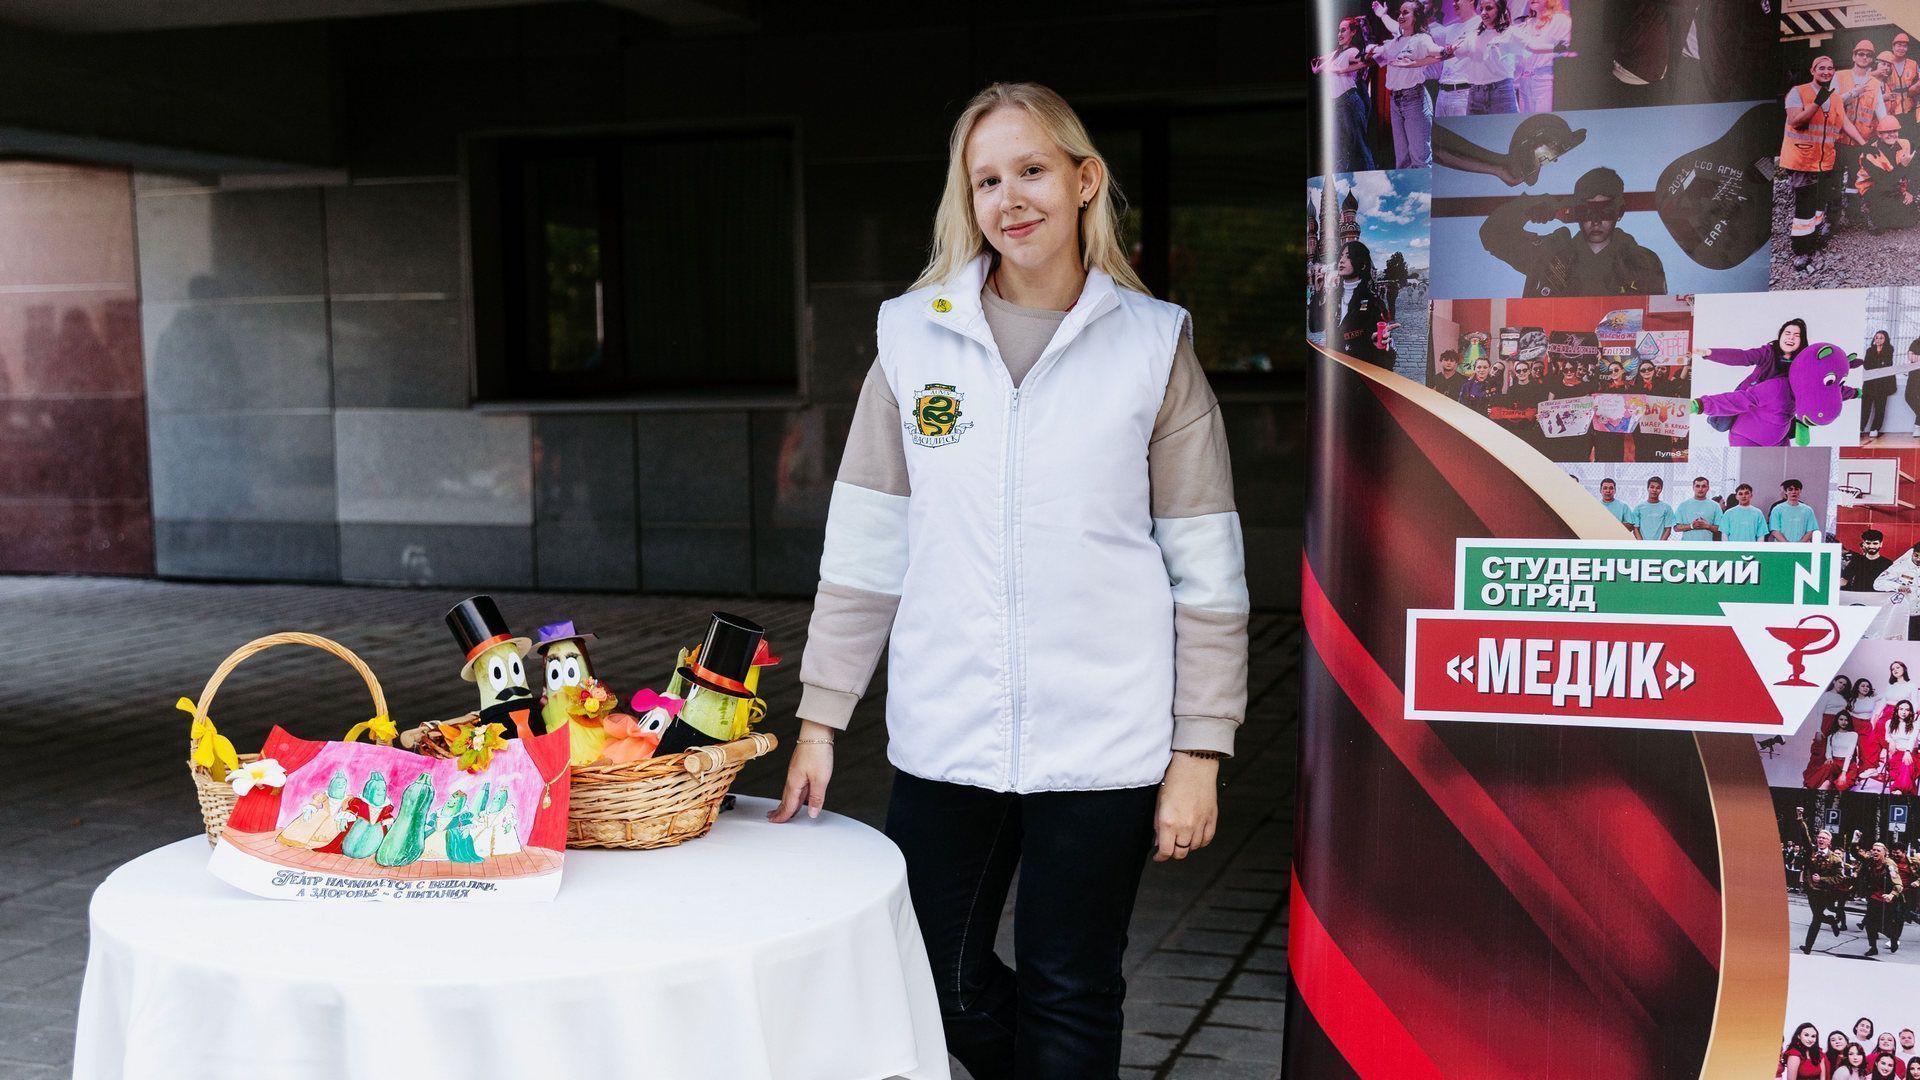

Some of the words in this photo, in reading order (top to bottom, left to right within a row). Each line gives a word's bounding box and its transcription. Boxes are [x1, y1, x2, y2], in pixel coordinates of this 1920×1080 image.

[1669, 169, 1690, 195] 2021
[1695, 160, 1713, 171] ССО
[1481, 555, 1760, 585] СТУДЕНЧЕСКИЙ
[1481, 583, 1596, 612] ОТРЯД
[1446, 637, 1696, 708] «МЕДИК»
[1829, 810, 1838, 823] P
[1894, 807, 1904, 821] P
[271, 869, 323, 886] ТЕАТР
[325, 877, 413, 890] НАЧИНАЕТСЯ
[416, 881, 425, 889] С
[296, 888, 305, 897] А
[309, 888, 379, 899] ЗДОРОВЬЕ
[393, 890, 402, 899] С
[405, 889, 471, 899] ПИТАНИЯ
